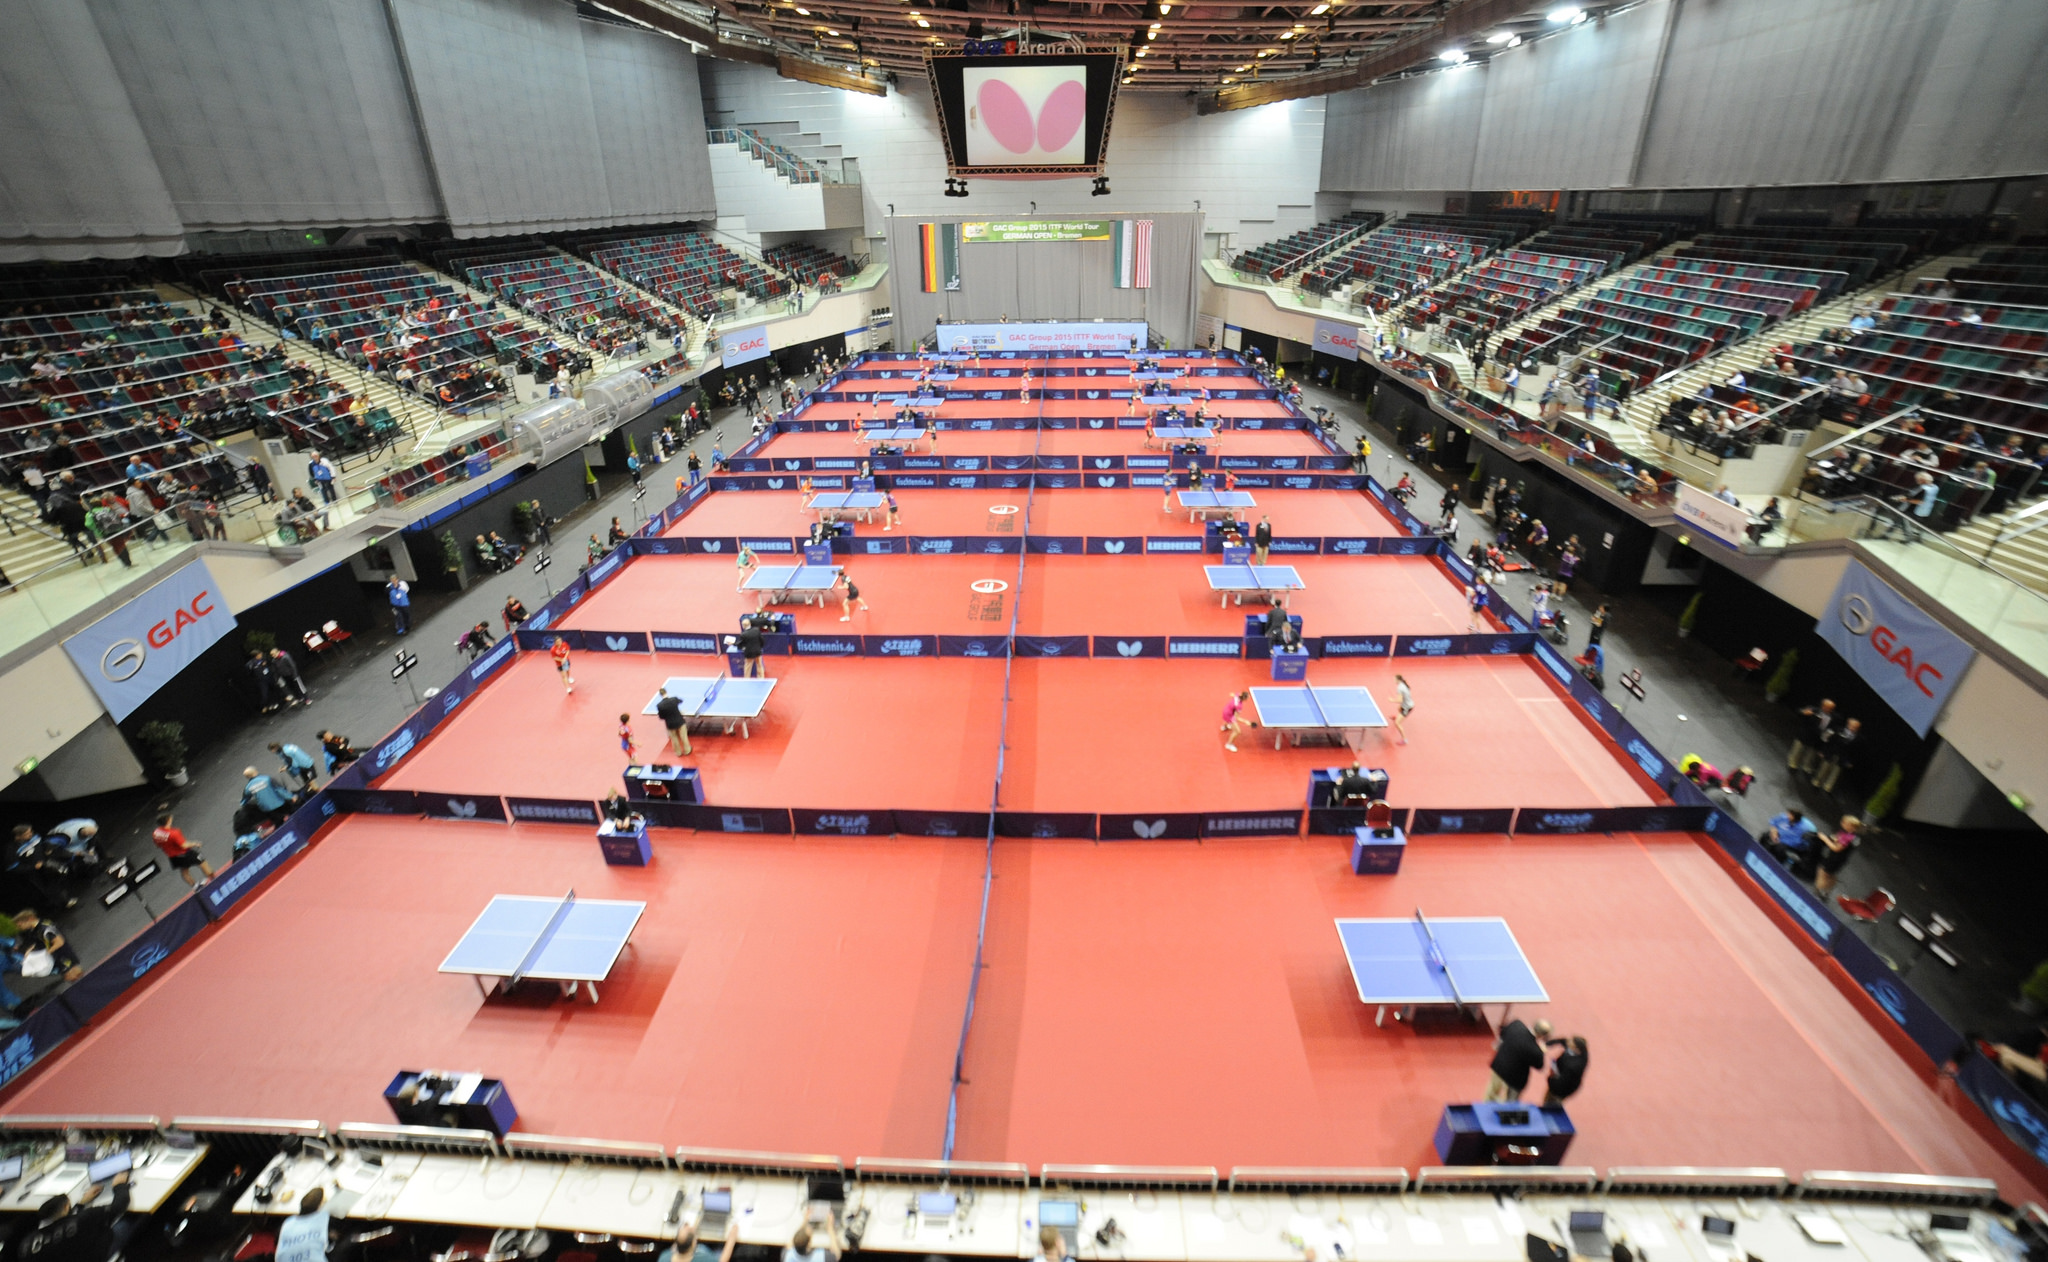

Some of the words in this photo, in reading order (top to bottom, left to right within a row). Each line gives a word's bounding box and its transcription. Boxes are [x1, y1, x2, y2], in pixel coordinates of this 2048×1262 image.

[1018, 41, 1066, 56] Arena
[1063, 223, 1083, 231] World
[1084, 222, 1100, 230] Tour
[739, 337, 765, 352] GAC
[1009, 334, 1027, 342] GAC
[1028, 334, 1051, 343] Group
[1073, 333, 1090, 341] ITTF
[1092, 333, 1115, 341] World
[1331, 335, 1357, 350] GAC
[1146, 541, 1201, 551] LIEBHERR
[147, 590, 215, 650] GAC
[654, 636, 716, 651] LIEBHERR
[796, 640, 856, 654] fischtennis.de
[1169, 642, 1240, 655] LIEBHERR
[1325, 640, 1384, 654] fischtennis.de
[1869, 625, 1944, 699] GAC
[1206, 816, 1296, 832] LIEBHERR
[209, 830, 298, 907] LIEBHERR
[282, 1231, 321, 1249] PHOTO
